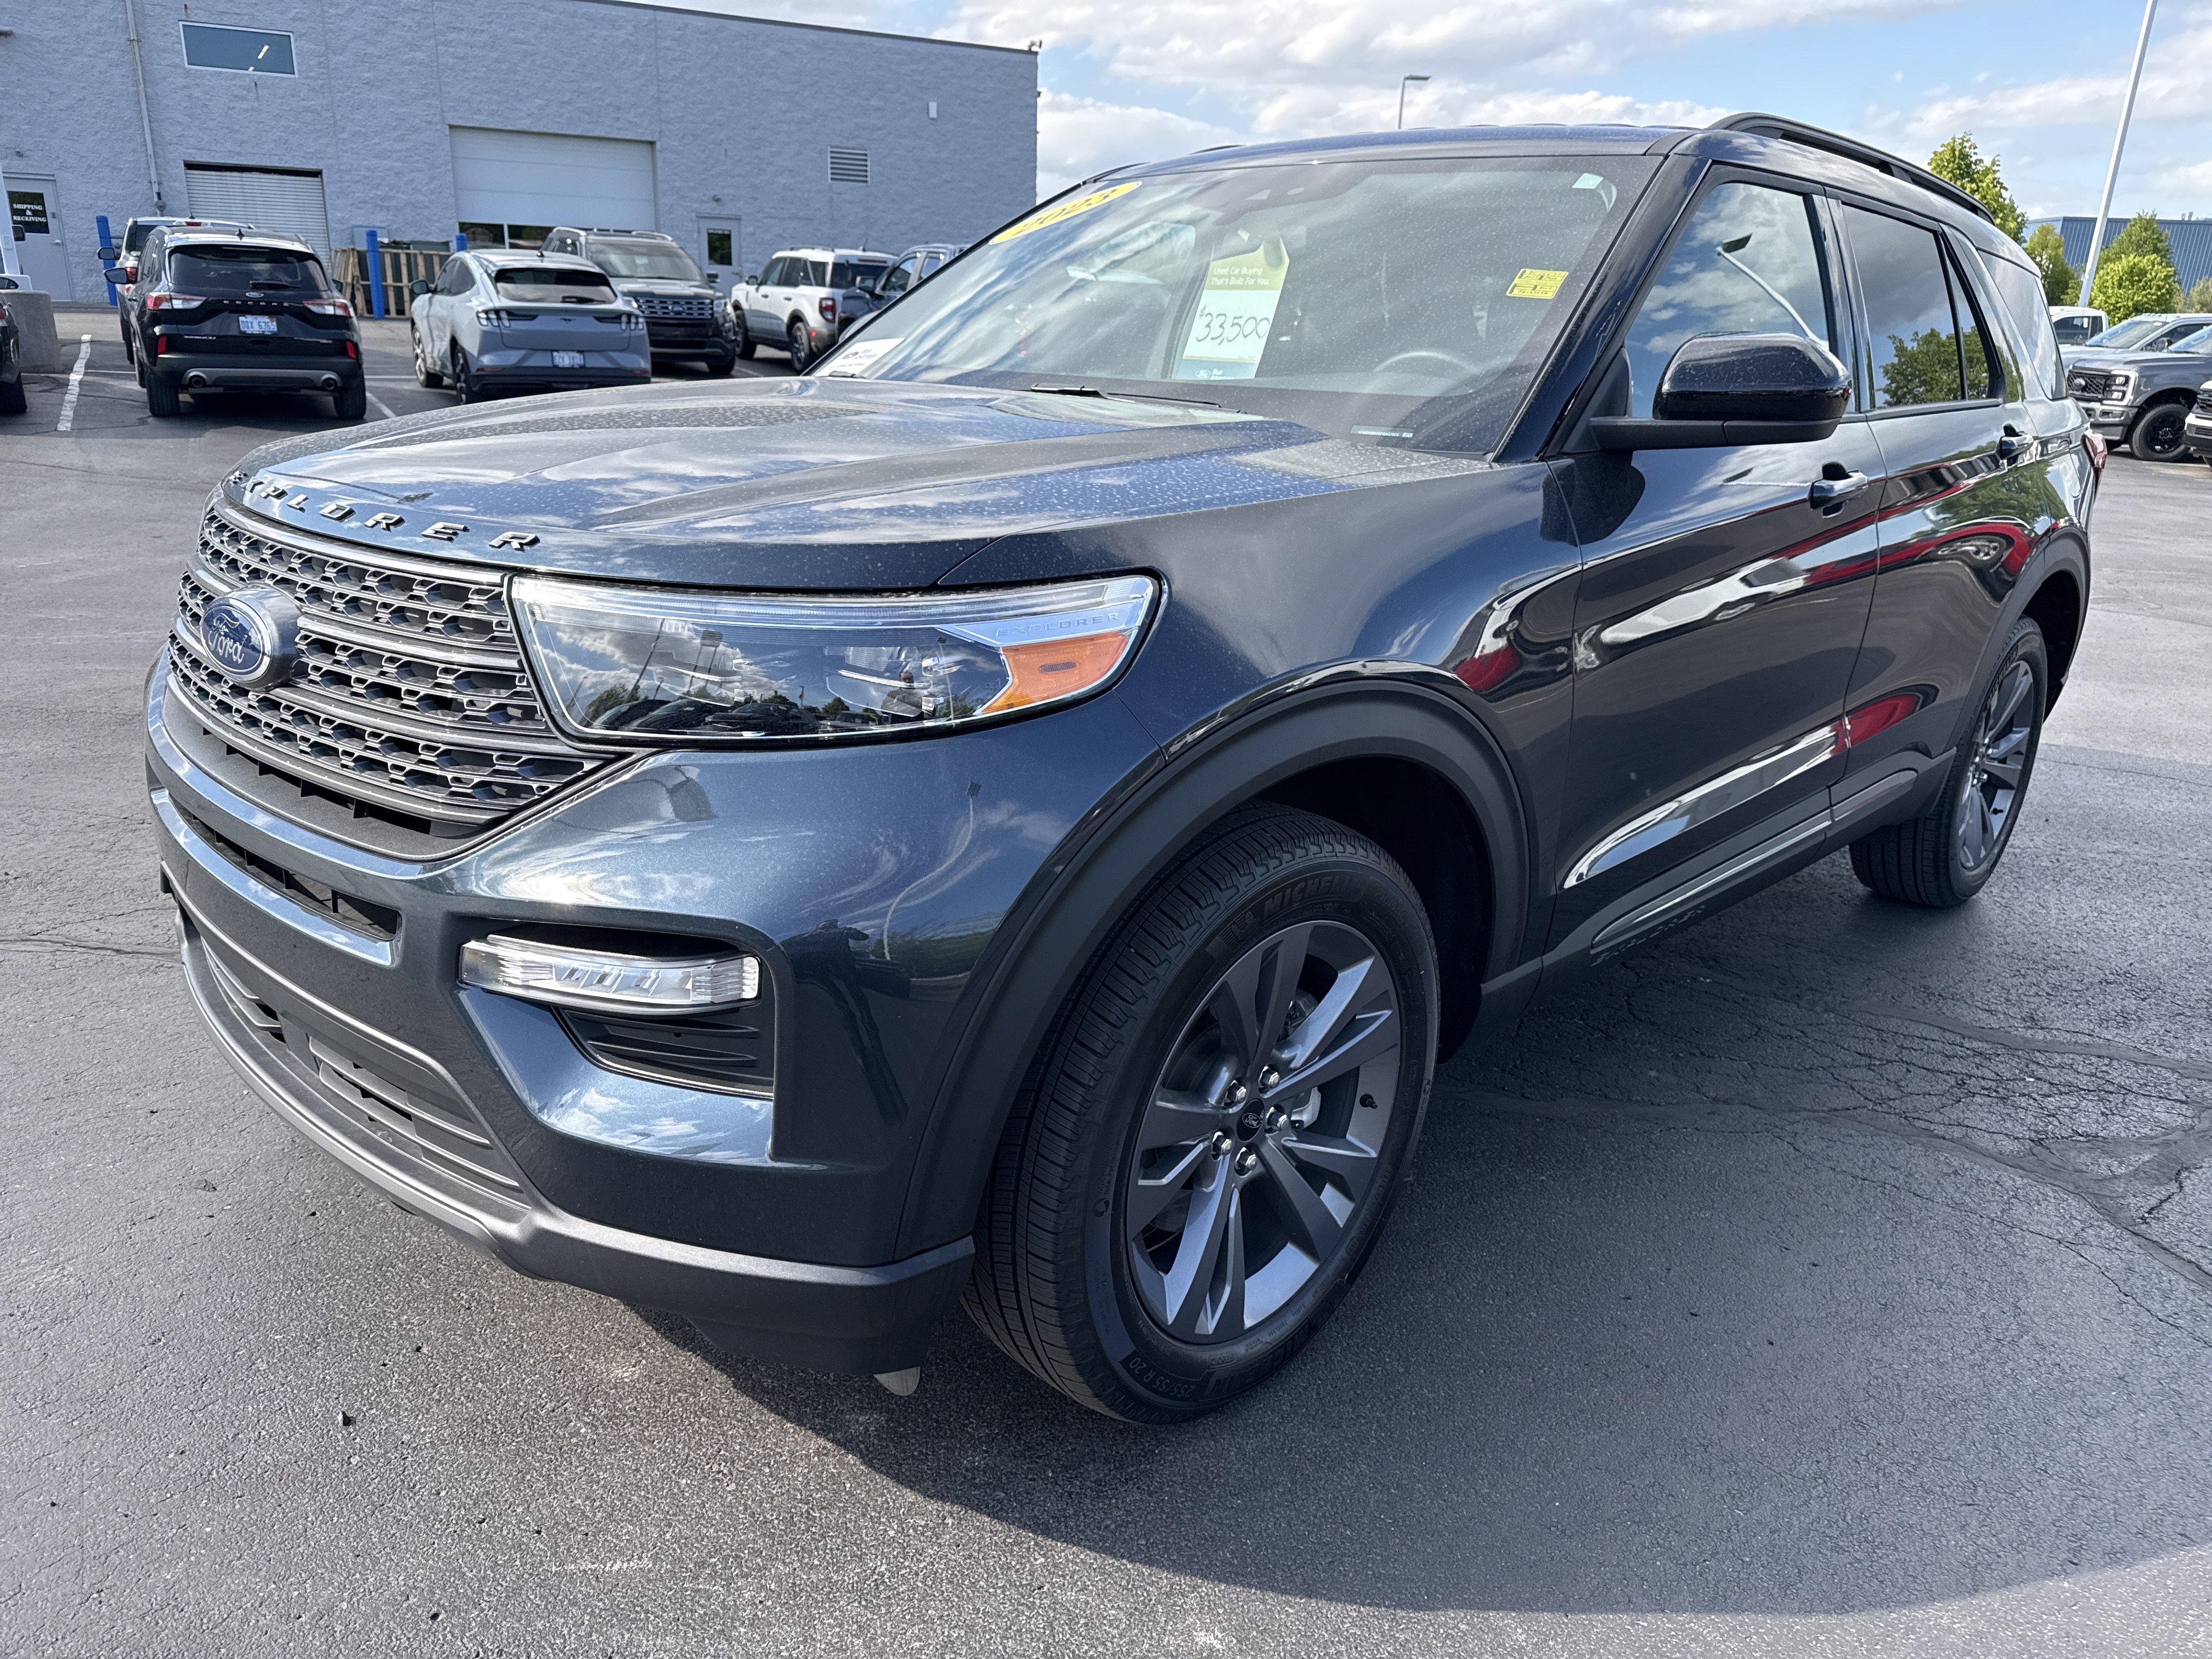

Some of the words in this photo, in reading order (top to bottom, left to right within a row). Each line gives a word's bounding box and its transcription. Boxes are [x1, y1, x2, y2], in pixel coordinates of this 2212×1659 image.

[1012, 189, 1118, 237] 2023
[1242, 267, 1262, 276] Buying
[1196, 304, 1270, 346] $33,500
[231, 471, 540, 552] EXPLORER
[208, 613, 245, 664] Ford
[996, 612, 1119, 637] EXPLORER
[1263, 876, 1367, 919] MICHELIN
[1245, 1114, 1259, 1127] Ford
[1098, 1146, 1113, 1195] MICHELIN
[1107, 1128, 1124, 1177] Performance
[1128, 1357, 1147, 1374] 20
[1143, 1369, 1156, 1383] R
[1152, 1376, 1196, 1398] 255/55
